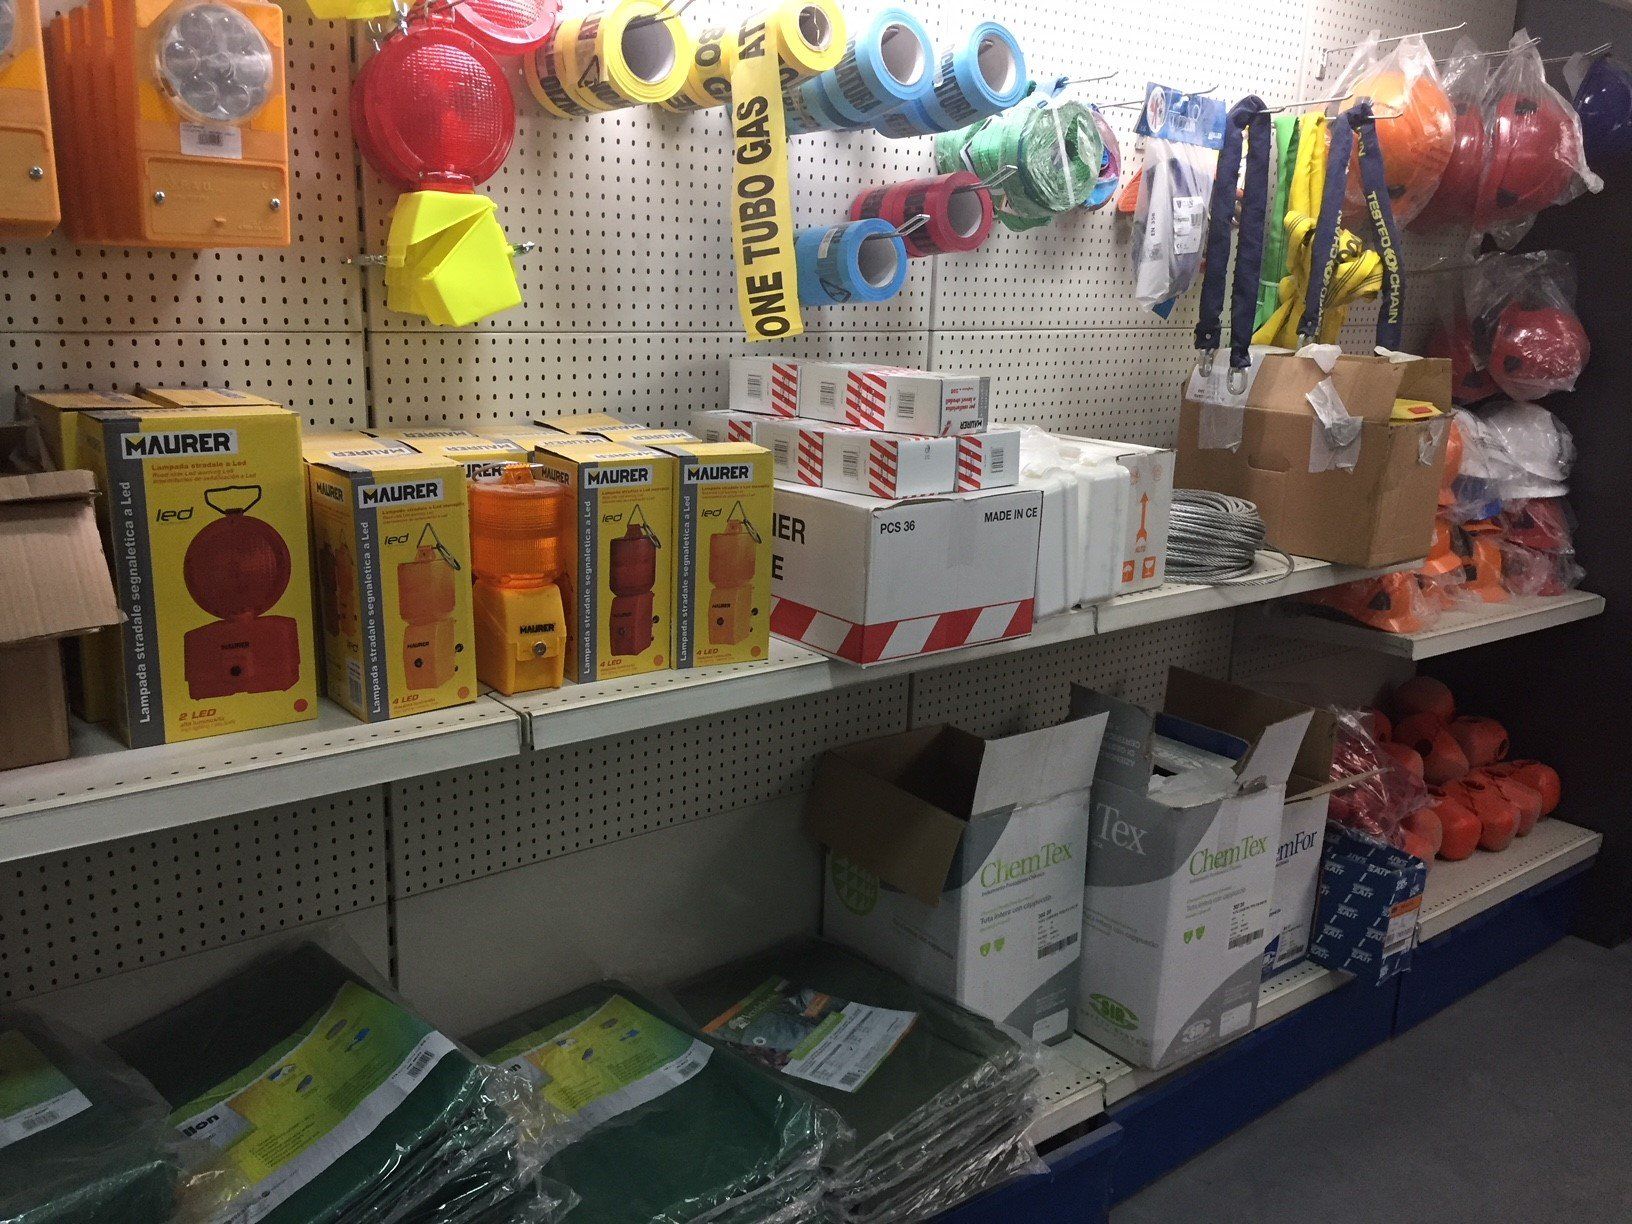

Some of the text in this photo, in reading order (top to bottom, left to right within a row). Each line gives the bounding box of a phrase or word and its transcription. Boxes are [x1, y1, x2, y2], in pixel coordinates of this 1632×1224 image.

[736, 96, 772, 164] GAS
[736, 173, 779, 266] TUBO
[1367, 190, 1401, 324] TESTED CHAIN
[745, 271, 791, 338] ONE
[125, 432, 230, 456] MAURER
[588, 468, 648, 486] MAURER
[687, 465, 749, 482] MAURER
[118, 482, 132, 504] Led
[316, 482, 344, 502] MAURER
[363, 482, 438, 504] MAURER
[156, 506, 194, 522] led
[602, 512, 623, 523] led
[701, 508, 722, 518] led
[880, 520, 915, 535] PCS 36
[984, 508, 1038, 523] MADE IN CE
[360, 522, 370, 540] Led
[384, 532, 410, 546] led
[124, 520, 141, 600] segnaletica
[584, 528, 592, 586] segnaletica
[682, 522, 690, 576] segnaletica
[362, 552, 376, 616] segnaletica
[132, 605, 146, 660] stradale
[368, 618, 378, 662] stradale
[520, 622, 555, 635] MAURER
[680, 620, 690, 661] Lampada
[584, 630, 592, 674] Lampada
[607, 658, 622, 666] LED
[136, 664, 152, 723] Lampada
[371, 665, 382, 714] Lampada
[402, 694, 419, 703] LED
[178, 708, 217, 721] 2 LED
[1096, 802, 1148, 856] Tex
[1189, 834, 1268, 876] ChemTex
[1276, 830, 1318, 862] mFor
[980, 842, 1073, 890] ChemTex
